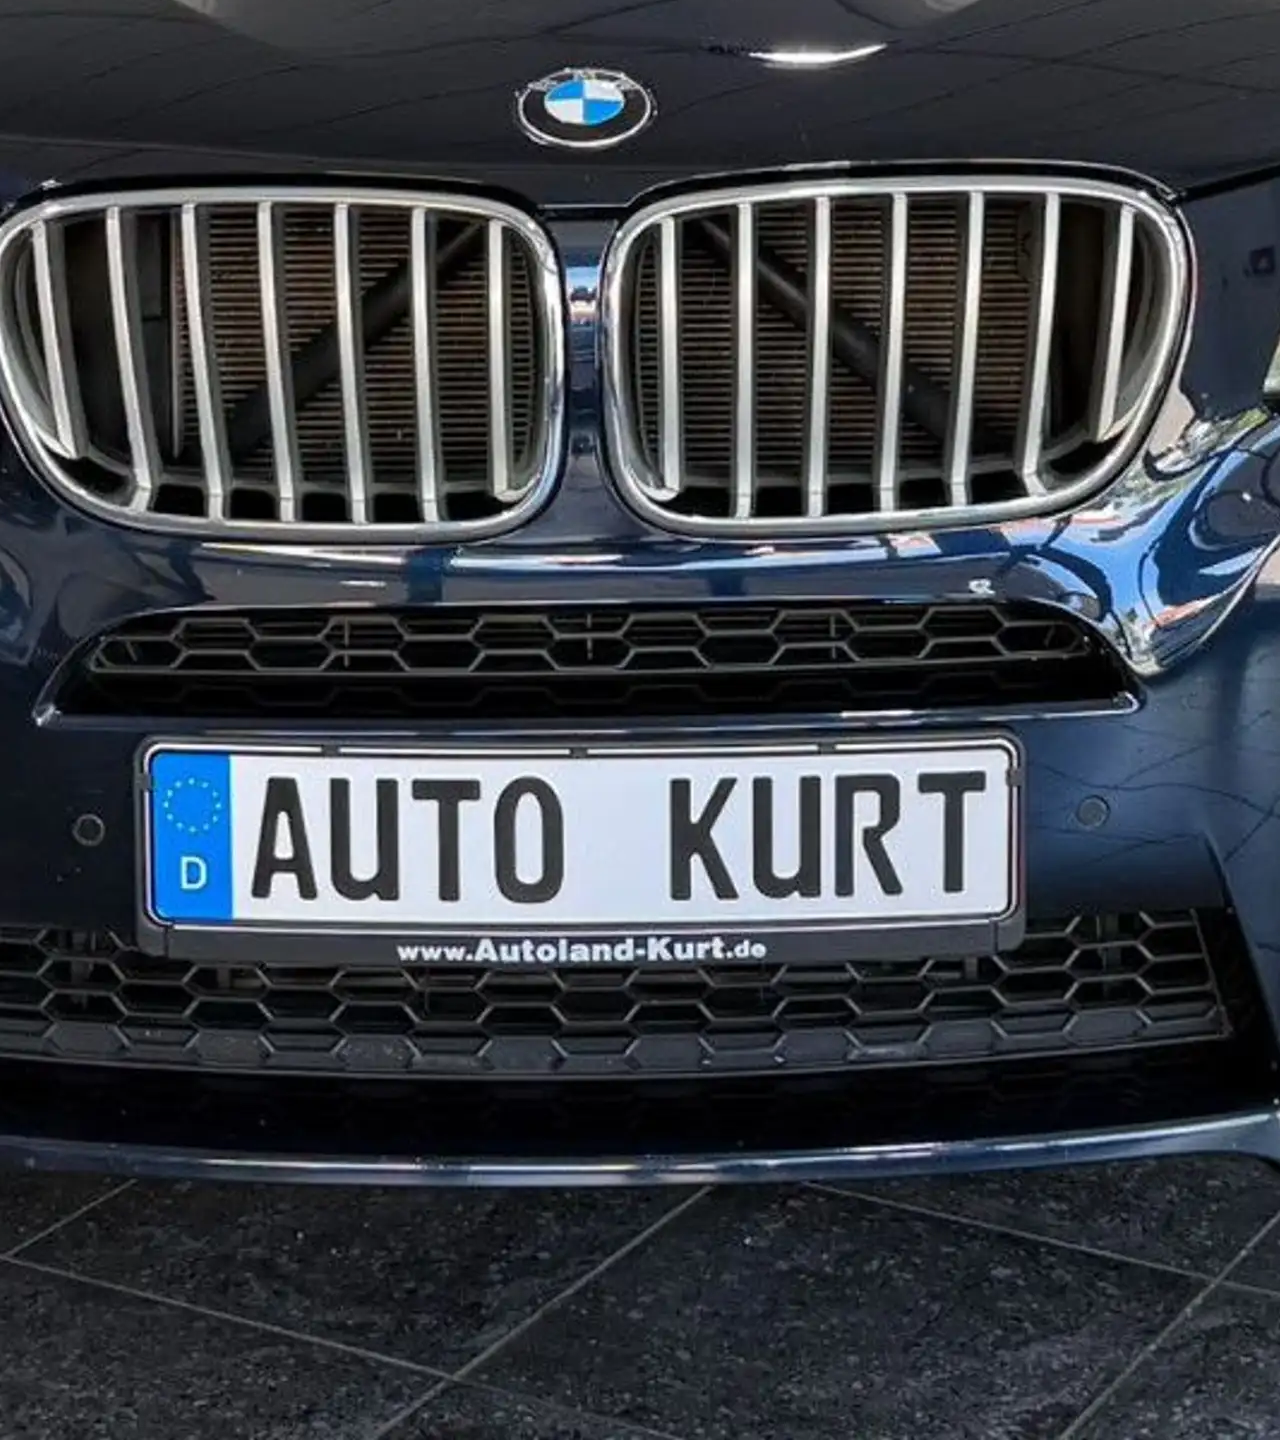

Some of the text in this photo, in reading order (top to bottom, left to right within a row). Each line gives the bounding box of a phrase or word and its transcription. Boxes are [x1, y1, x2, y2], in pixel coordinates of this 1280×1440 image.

[251, 771, 987, 904] AUTO KURT
[180, 856, 208, 890] D
[397, 935, 768, 962] www.Autoland-Kurt.de
